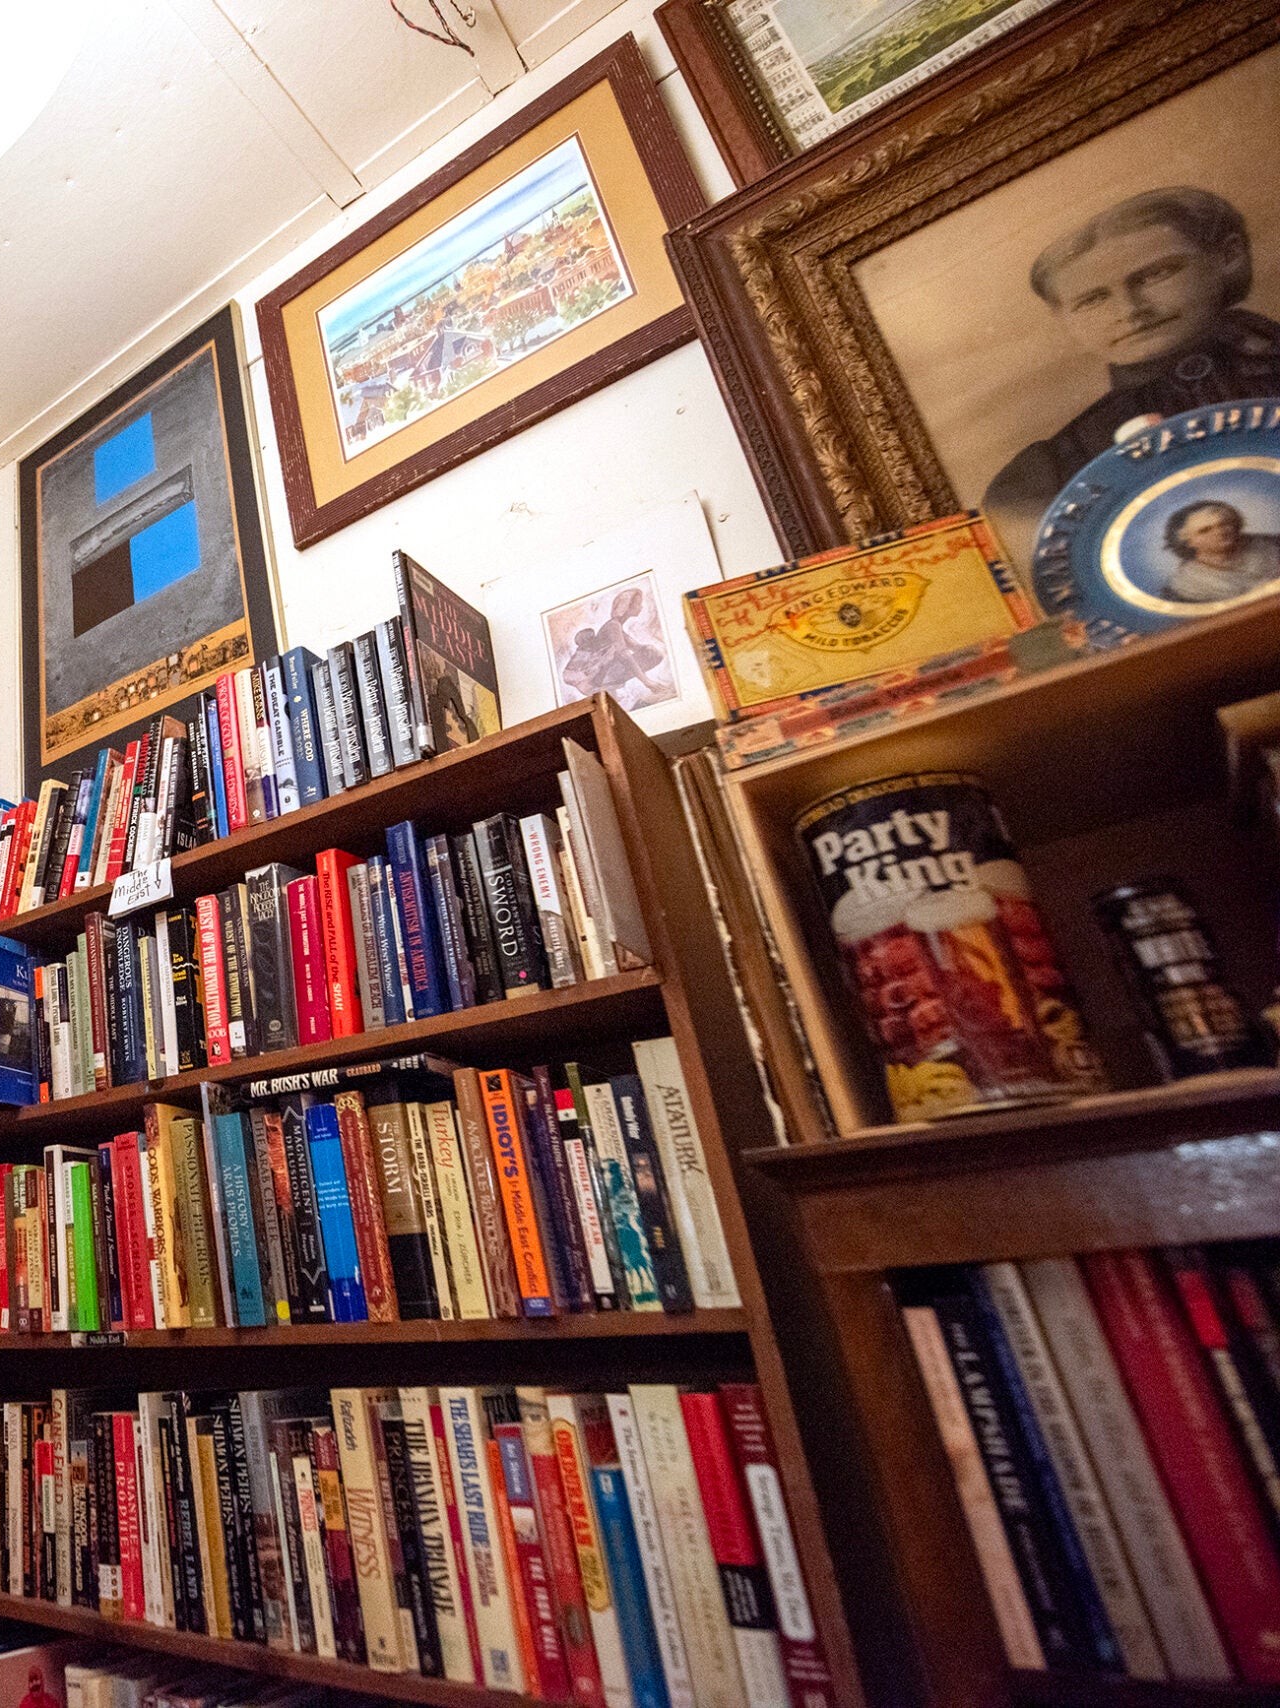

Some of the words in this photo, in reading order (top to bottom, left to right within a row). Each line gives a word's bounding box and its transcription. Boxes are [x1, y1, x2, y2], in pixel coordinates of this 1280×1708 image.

[827, 576, 907, 600] EDWARD
[251, 674, 261, 693] MIKE
[266, 673, 276, 690] THE
[253, 693, 264, 719] EVANS
[269, 692, 280, 718] GREAT
[273, 719, 285, 756] GAMBLE
[298, 708, 311, 739] WHERE
[135, 733, 149, 783] MUQTADA
[303, 740, 315, 762] GOD
[168, 773, 176, 793] ISLAMIC
[129, 796, 140, 824] PATRICK
[124, 825, 136, 862] COCKBURN
[528, 831, 544, 865] WRONG
[812, 809, 950, 876] Party
[115, 877, 148, 899] Middle
[130, 869, 148, 880] The
[322, 871, 331, 888] The
[535, 867, 551, 899] ENEMY
[844, 851, 974, 901] King
[127, 884, 151, 905] East
[323, 889, 333, 910] RISE
[399, 870, 420, 933] ANTISEMITISM
[198, 899, 214, 929] GUEST
[326, 913, 334, 928] and
[377, 914, 387, 937] WHAT
[487, 875, 518, 957] SWORD
[503, 872, 527, 952] CONSTANTINE'S
[200, 931, 215, 944] OF
[224, 920, 235, 943] GUEST
[301, 929, 309, 955] TRANSITION
[327, 929, 337, 953] FALL
[408, 934, 421, 946] IN
[87, 925, 98, 985] CONSTANTINOPLE
[115, 927, 125, 991] KNOWLEDGE
[121, 927, 132, 988] DANGEROUS
[201, 944, 216, 964] THE
[226, 945, 236, 954] OF
[227, 955, 237, 971] THE
[329, 954, 338, 964] of
[380, 938, 390, 961] WENT
[331, 966, 340, 982] the
[383, 962, 395, 997] WRONG?
[409, 948, 428, 992] AMERICA
[108, 993, 116, 1019] MIDDLE
[203, 966, 221, 1027] REVOLUTION
[228, 972, 240, 1016] REVOLUTION
[332, 982, 343, 1011] SHAH
[120, 997, 128, 1031] ROBERT
[253, 1117, 267, 1149] THE
[430, 1104, 457, 1169] Turkey
[490, 1103, 520, 1178] IDIOT'S
[182, 1123, 201, 1210] PASSIONATE
[257, 1152, 272, 1183] ARAB
[284, 1135, 302, 1208] DELUSIONS
[292, 1124, 313, 1215] MAGNIFICENT
[377, 1121, 401, 1194] STORM
[222, 1164, 234, 1198] ARAB
[149, 1189, 166, 1254] WARRIORS
[262, 1187, 280, 1243] CENTER
[509, 1189, 526, 1224] Middle
[226, 1202, 240, 1257] PEOPLES
[516, 1226, 531, 1249] East
[191, 1213, 209, 1286] PILGRIMS
[521, 1250, 540, 1294] Conflict
[51, 1398, 63, 1450] CAIN'S
[448, 1396, 470, 1421] THE
[227, 1398, 246, 1458] SHIMON
[452, 1420, 478, 1471] SHAH'S
[52, 1455, 64, 1504] FIELD
[234, 1461, 252, 1514] PERES
[460, 1472, 484, 1509] LAST
[115, 1461, 130, 1561] PROPHET
[178, 1498, 193, 1550] REBEL
[466, 1509, 491, 1549] RIDE
[183, 1555, 198, 1599] LAND
